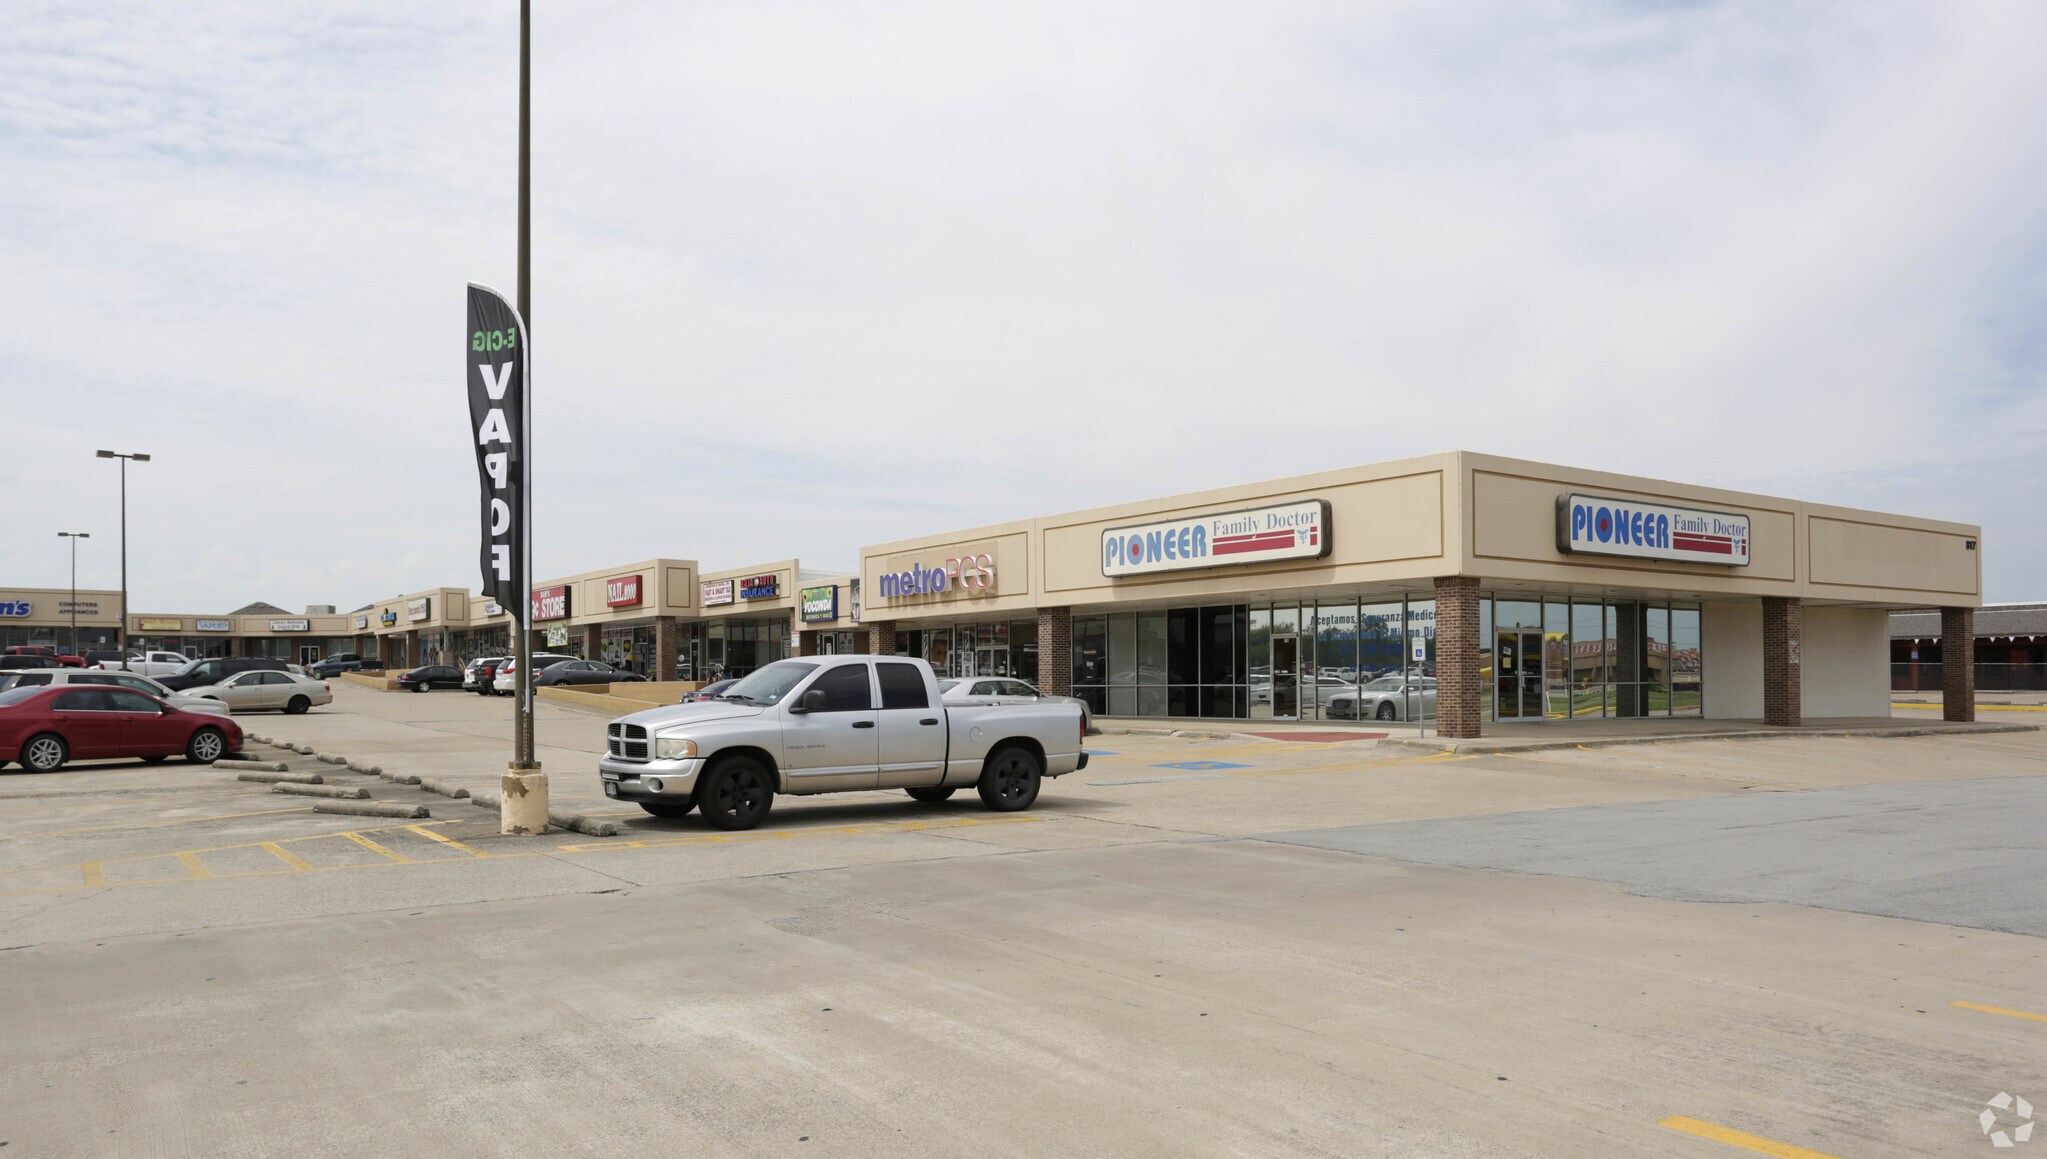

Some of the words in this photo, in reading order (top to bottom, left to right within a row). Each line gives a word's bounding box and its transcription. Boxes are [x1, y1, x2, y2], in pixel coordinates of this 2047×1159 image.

[1572, 504, 1669, 549] PIONEER
[1674, 514, 1708, 534] Family
[1713, 518, 1746, 537] Doctor
[1105, 524, 1207, 568] PIONEER
[1213, 516, 1260, 536] Family
[1266, 511, 1317, 530] Doctor
[759, 576, 774, 585] AUTO
[880, 554, 993, 598] metroPCS
[607, 582, 623, 603] NAIL
[740, 586, 774, 598] INSURANCE
[542, 596, 565, 618] STORE
[1310, 614, 1355, 626] Aceptamos
